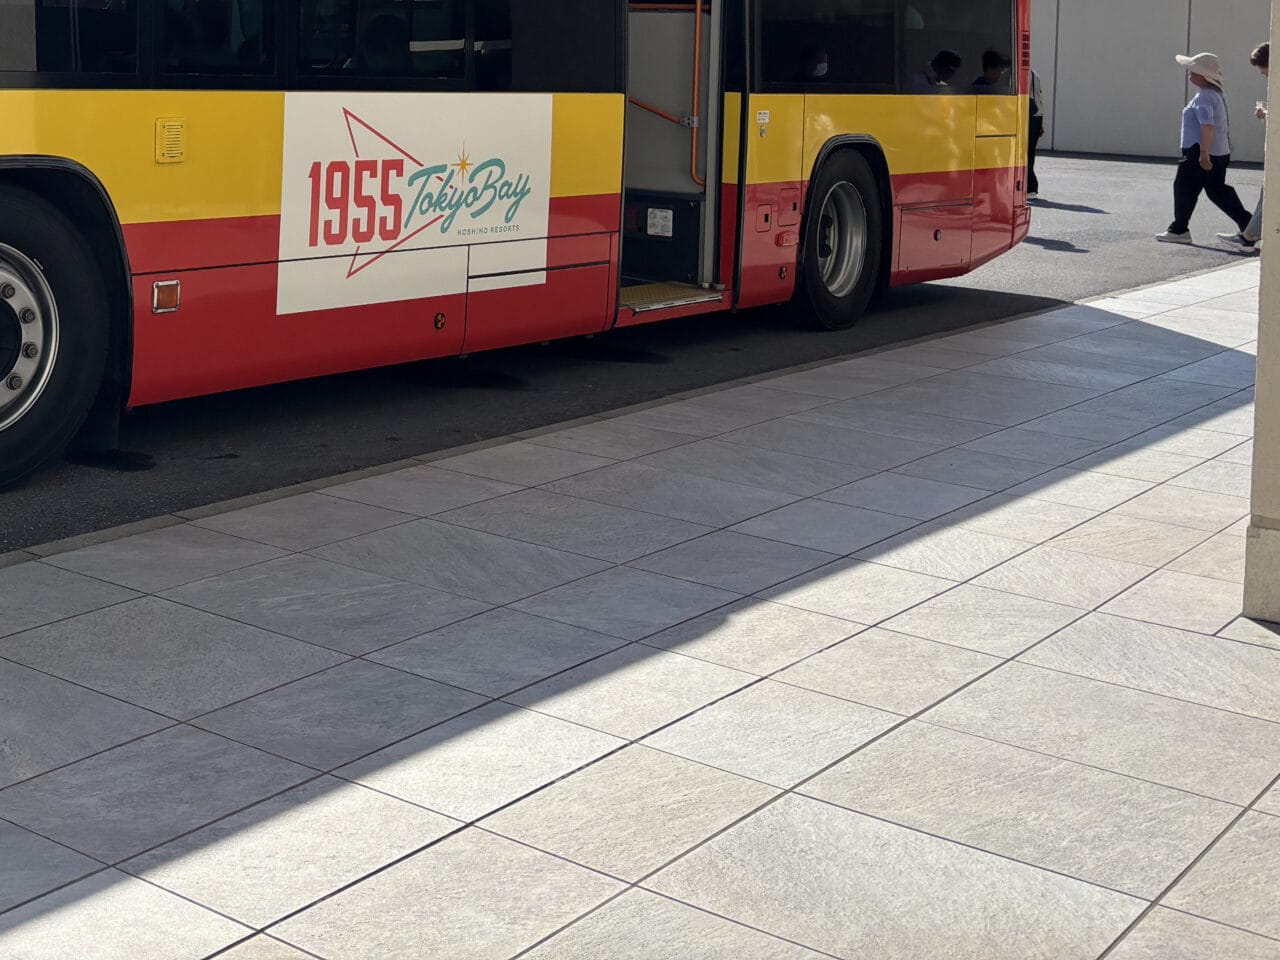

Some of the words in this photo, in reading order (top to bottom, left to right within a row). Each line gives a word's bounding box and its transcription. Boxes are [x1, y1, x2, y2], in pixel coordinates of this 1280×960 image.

[308, 158, 404, 247] 1955
[457, 226, 488, 236] HOSHINO
[490, 224, 520, 234] RESORTS
